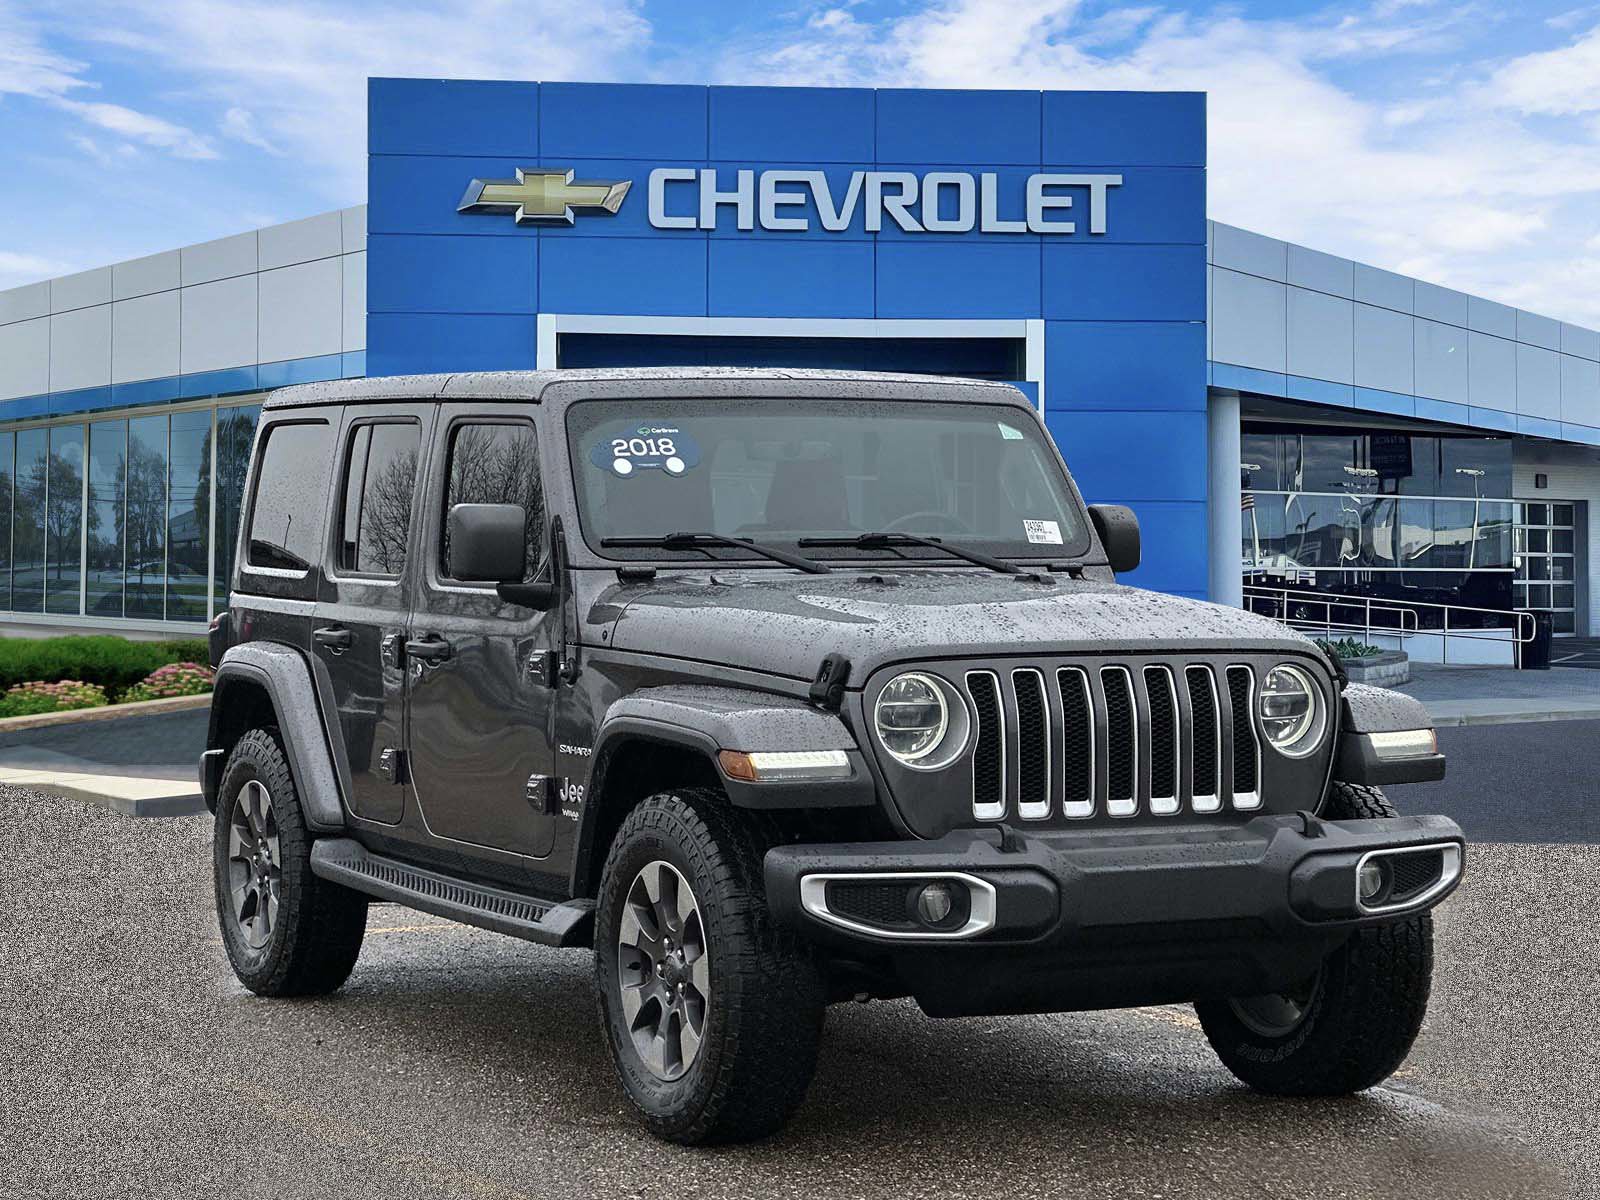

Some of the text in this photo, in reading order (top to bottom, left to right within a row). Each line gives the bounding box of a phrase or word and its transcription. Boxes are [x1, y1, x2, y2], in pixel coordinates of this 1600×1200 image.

[648, 168, 1122, 234] CHEVROLET
[611, 438, 676, 456] 2018
[559, 777, 584, 803] Jee
